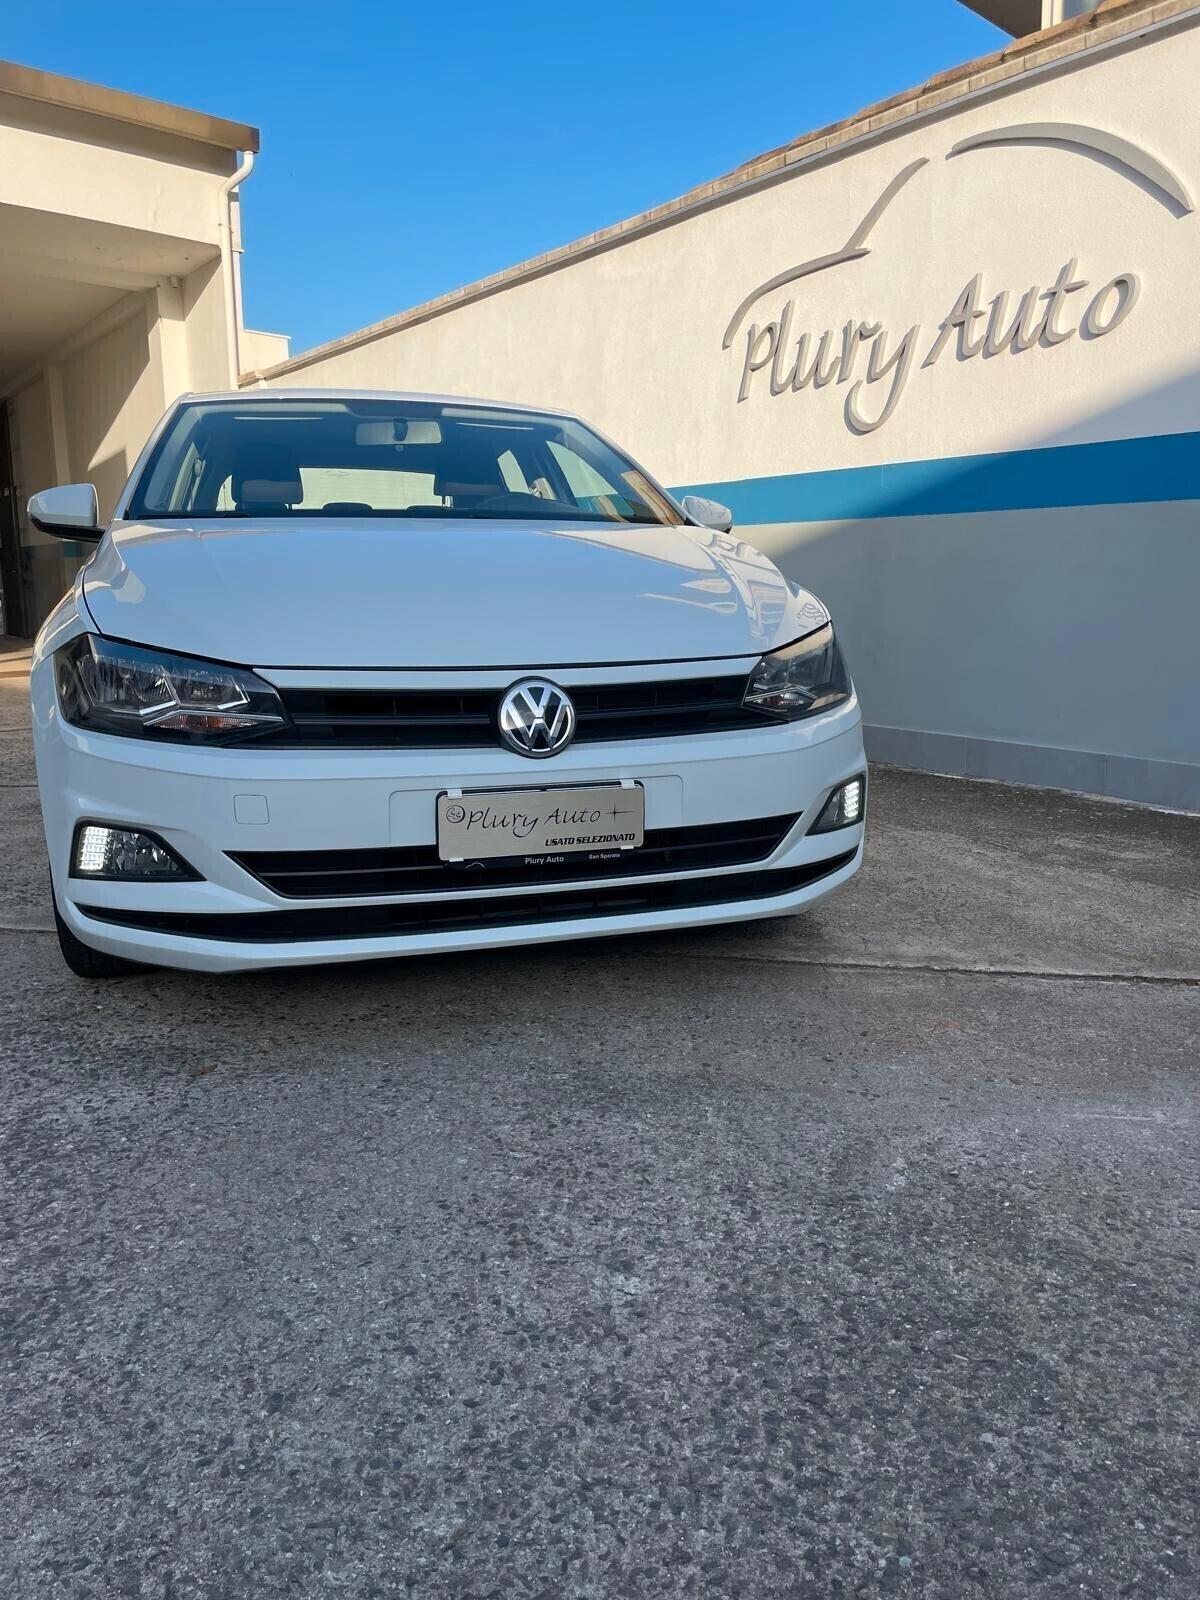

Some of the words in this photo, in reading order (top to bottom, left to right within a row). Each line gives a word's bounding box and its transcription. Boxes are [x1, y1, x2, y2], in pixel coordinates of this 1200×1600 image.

[737, 300, 920, 435] Plury
[921, 257, 1141, 369] Auto
[544, 807, 601, 825] Auto
[545, 837, 575, 847] USATO
[576, 833, 635, 845] SELEZIONATO
[525, 856, 545, 865] Plury
[546, 855, 565, 863] Auto
